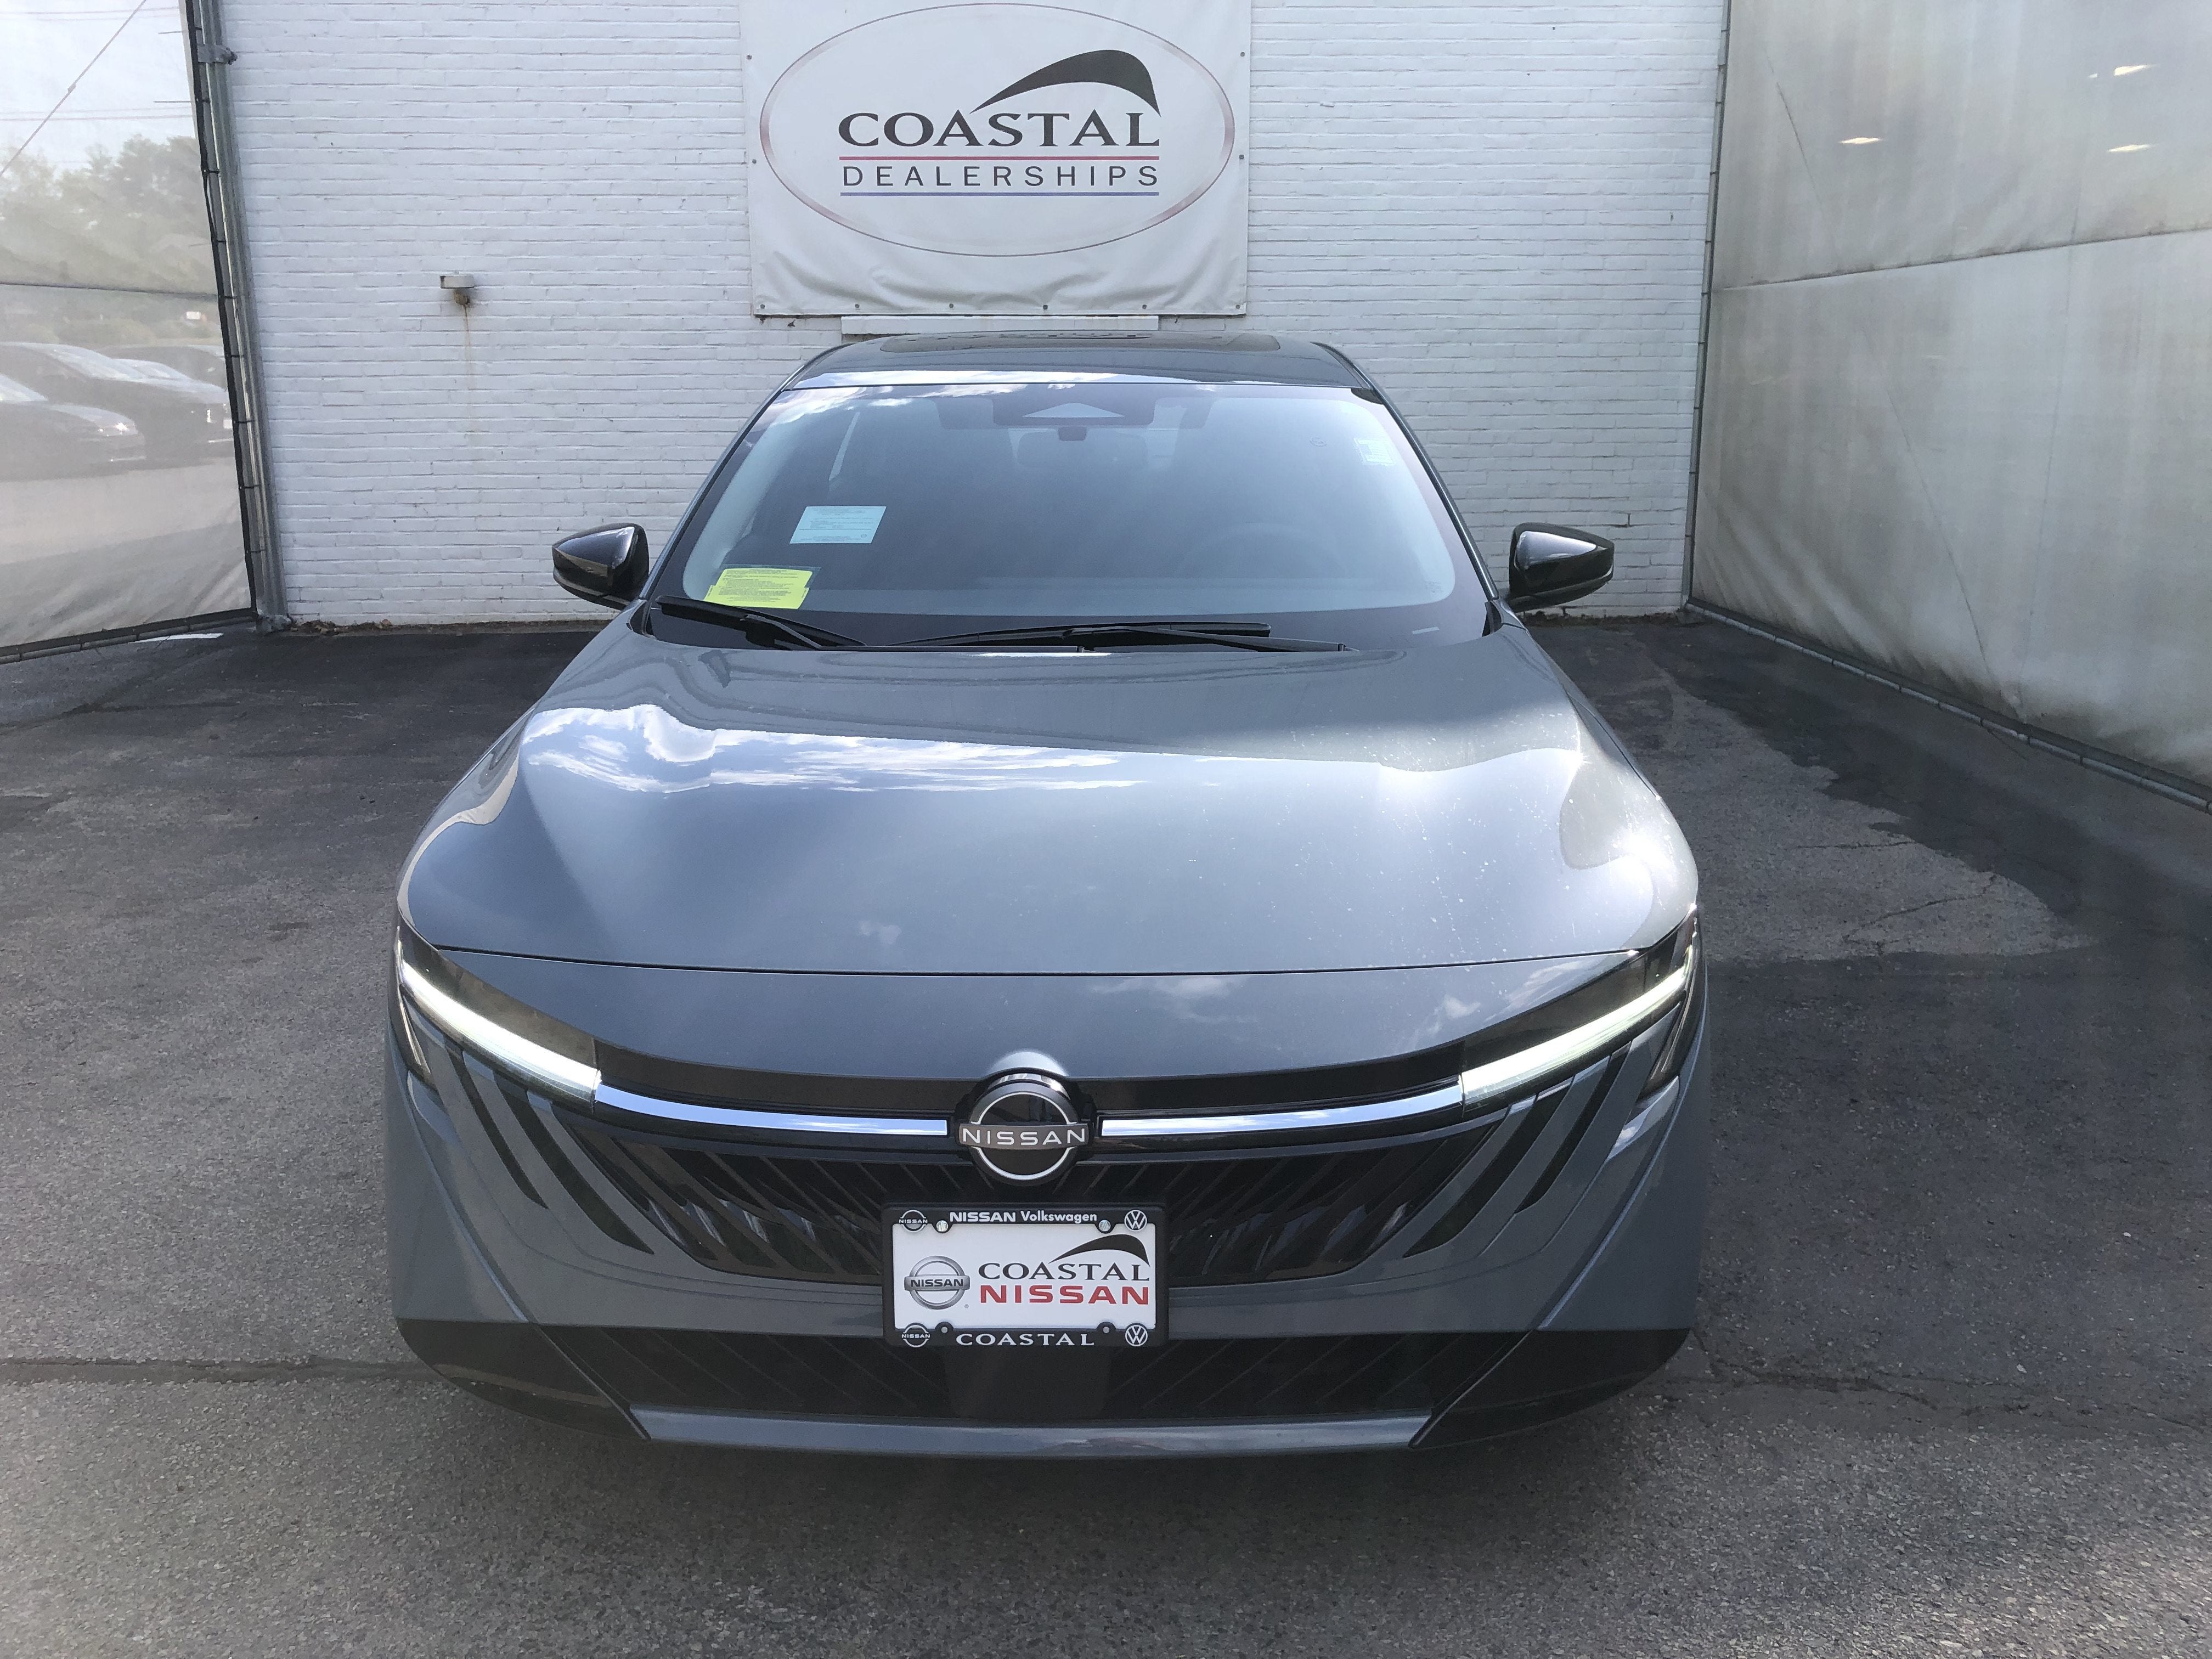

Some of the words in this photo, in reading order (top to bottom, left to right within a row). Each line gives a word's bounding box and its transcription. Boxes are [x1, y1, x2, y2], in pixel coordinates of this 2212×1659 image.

[838, 109, 1160, 146] COASTAL
[843, 166, 1159, 187] DEALERSHIPS
[963, 1128, 1085, 1146] NISSAN
[950, 1211, 1015, 1222] NISSAN
[1020, 1210, 1097, 1223] Volkswagen
[978, 1262, 1150, 1281] COASTAL
[911, 1278, 963, 1287] NISSAN
[980, 1285, 1149, 1305] NISSAN
[956, 1333, 1094, 1346] COASTAL
